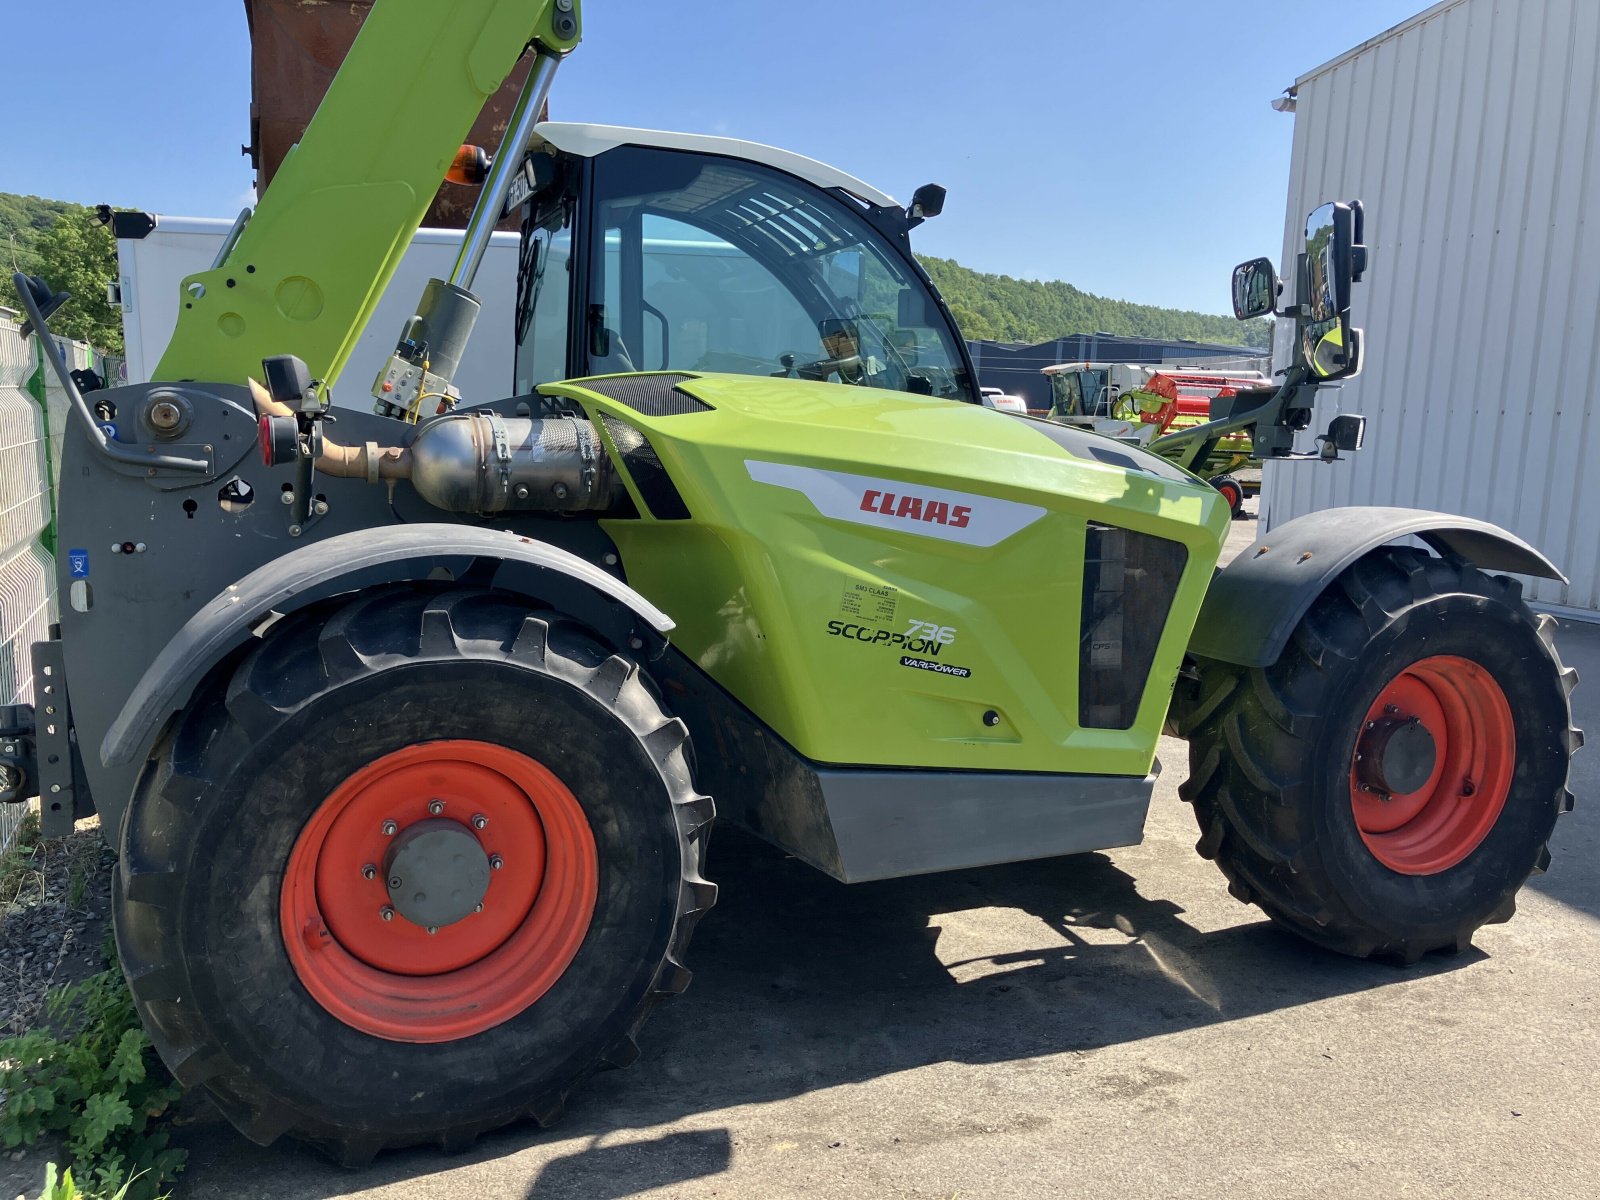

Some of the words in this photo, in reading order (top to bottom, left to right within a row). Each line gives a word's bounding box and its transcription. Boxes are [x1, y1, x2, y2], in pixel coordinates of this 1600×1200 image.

[860, 489, 972, 529] CLAAS
[868, 587, 889, 597] CLAAS
[827, 620, 943, 656] SCORPION
[903, 619, 957, 645] 736
[904, 658, 968, 677] VARIPOWER
